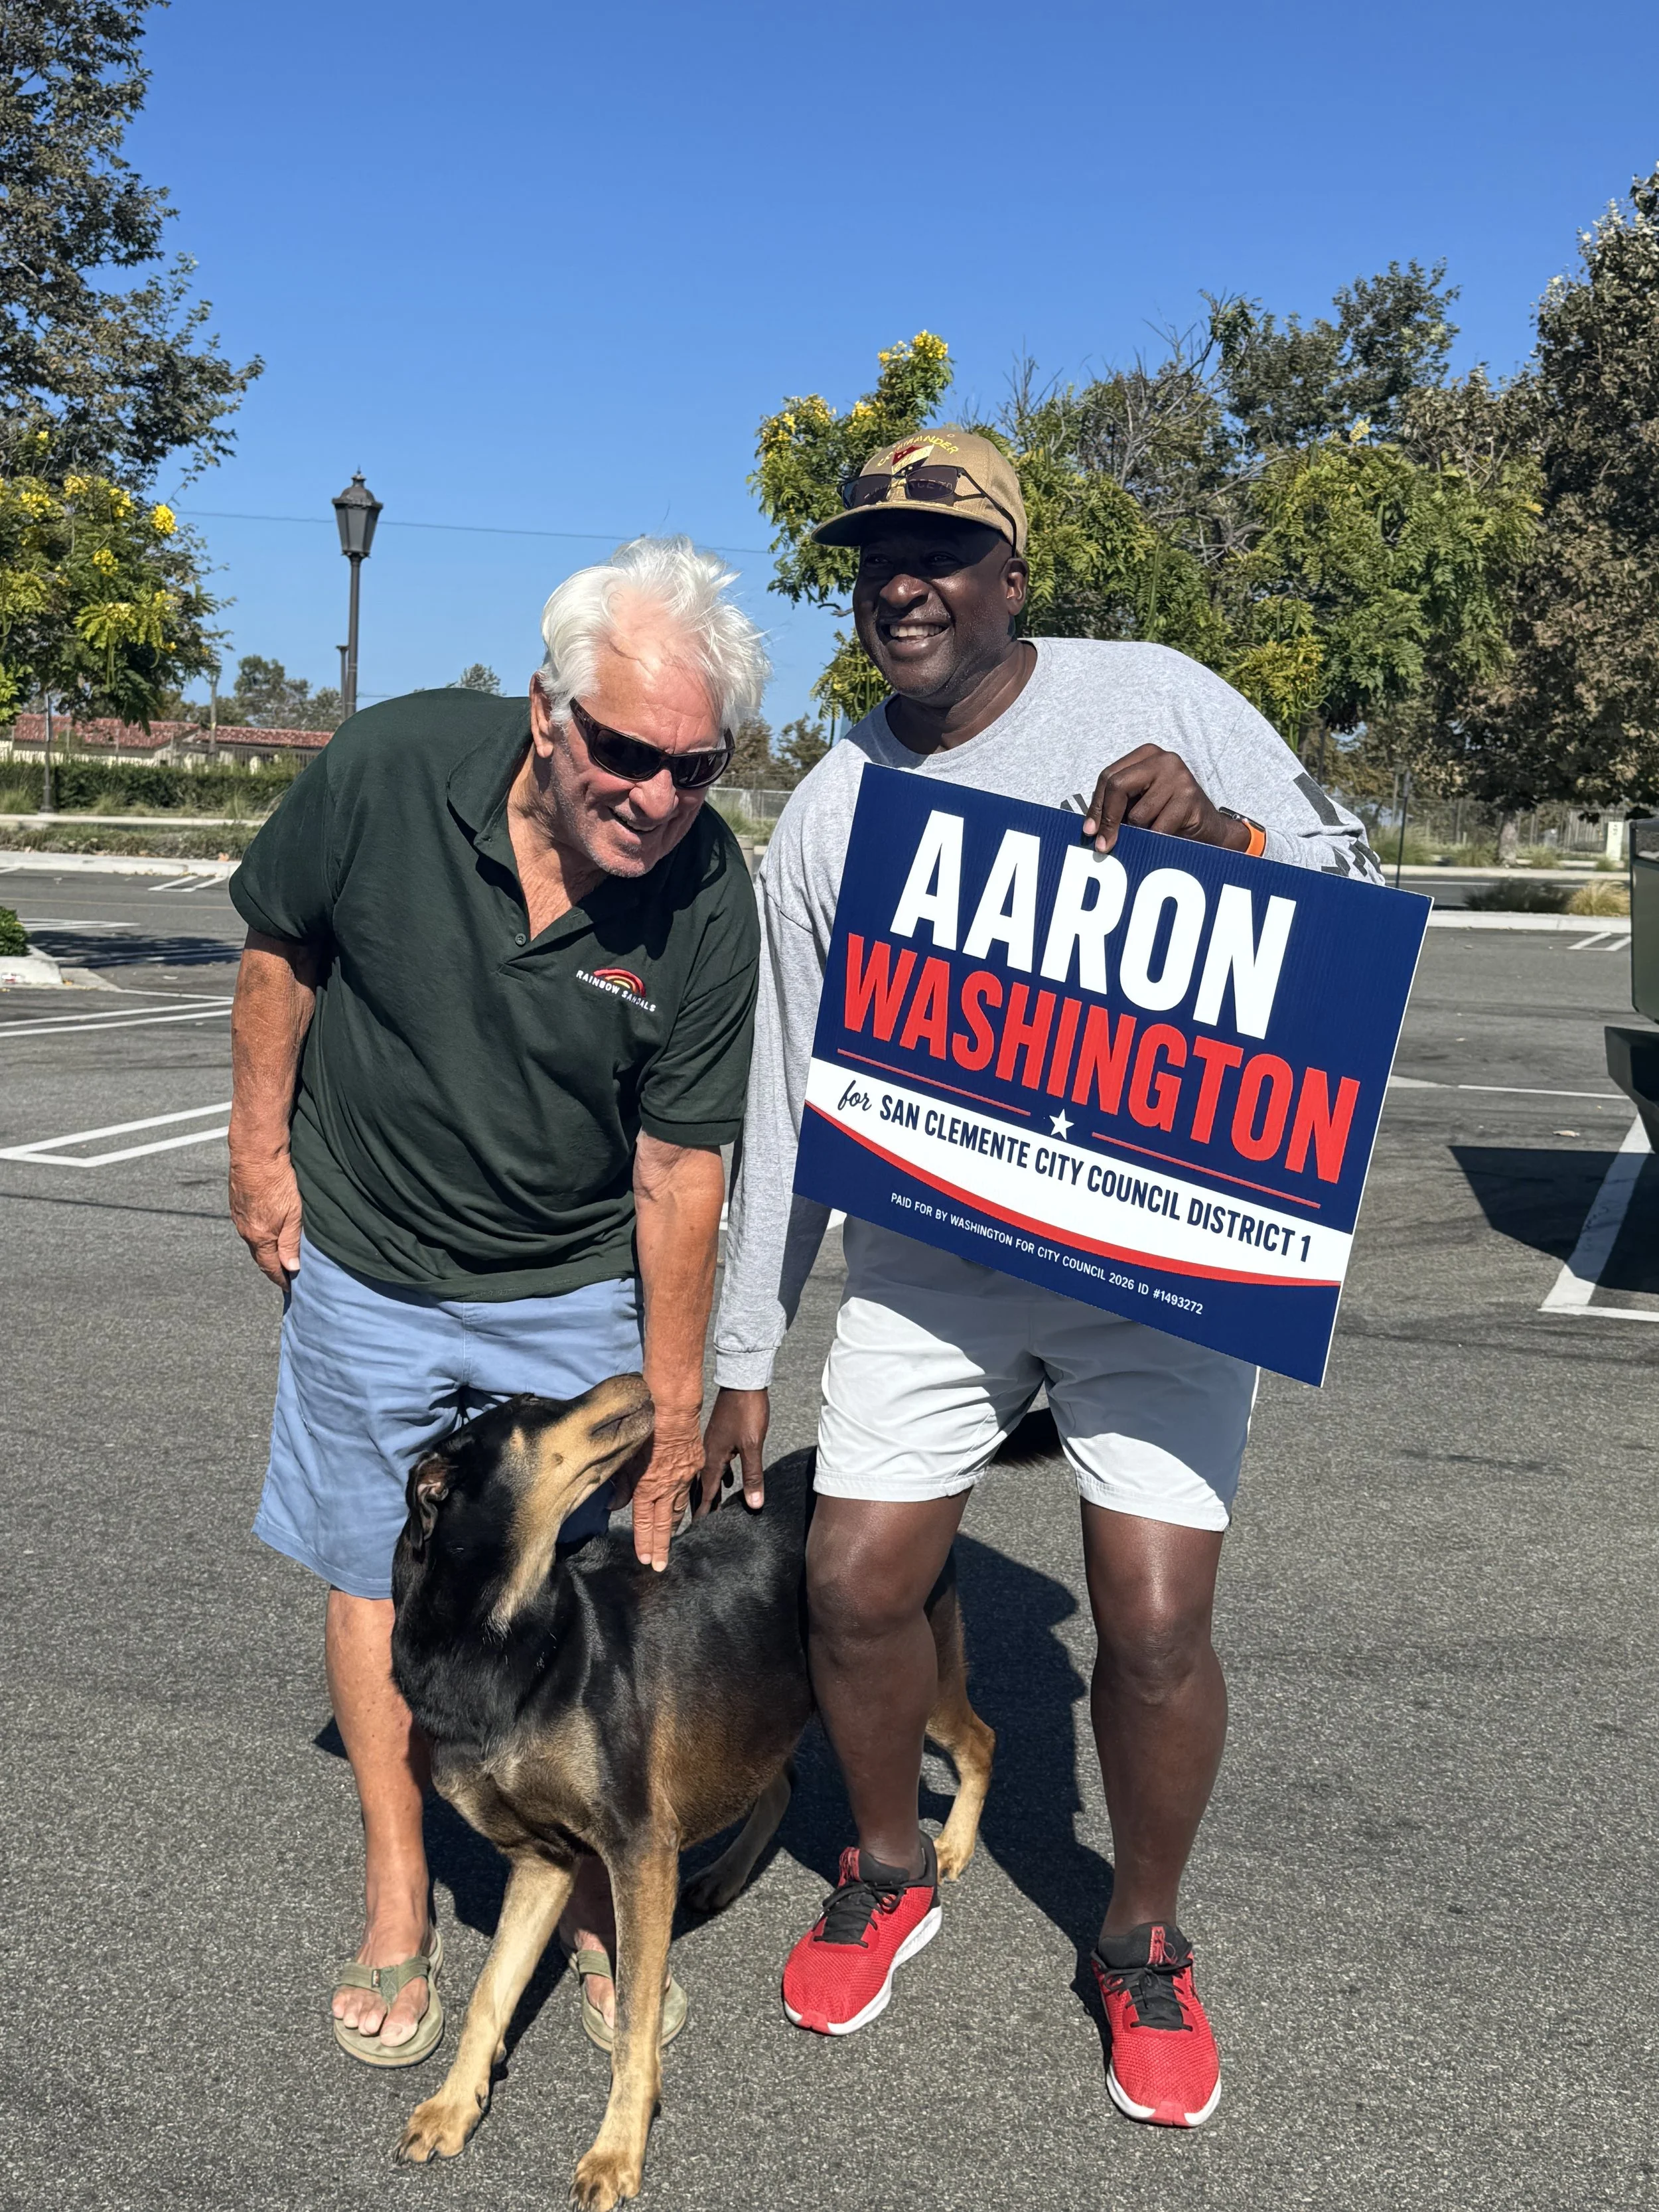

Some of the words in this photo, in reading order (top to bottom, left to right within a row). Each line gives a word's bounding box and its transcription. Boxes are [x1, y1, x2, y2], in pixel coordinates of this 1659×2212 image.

[575, 970, 620, 995] RAINBOW
[621, 990, 656, 1012] SANDALS
[889, 809, 1297, 1040] AARON
[844, 933, 1360, 1184] WASHINGTON
[837, 1080, 872, 1111] for
[879, 1094, 920, 1131] SAN
[924, 1110, 1031, 1169] CLEMENTE
[1035, 1147, 1084, 1186] CITY
[1087, 1165, 1181, 1220] COUNCIL
[1187, 1197, 1296, 1256] DISTRICT
[1300, 1235, 1311, 1262] 1
[891, 1193, 912, 1209] PAID
[914, 1201, 933, 1217] FOR
[935, 1209, 948, 1222] BY
[950, 1214, 1013, 1246] WASHINGTON
[1015, 1238, 1035, 1254] FOR
[1037, 1246, 1060, 1262] CITY
[1062, 1256, 1106, 1280] COUNCIL
[1108, 1272, 1135, 1290] 2026
[1137, 1282, 1149, 1295] ID
[1153, 1288, 1203, 1315] #1493272
